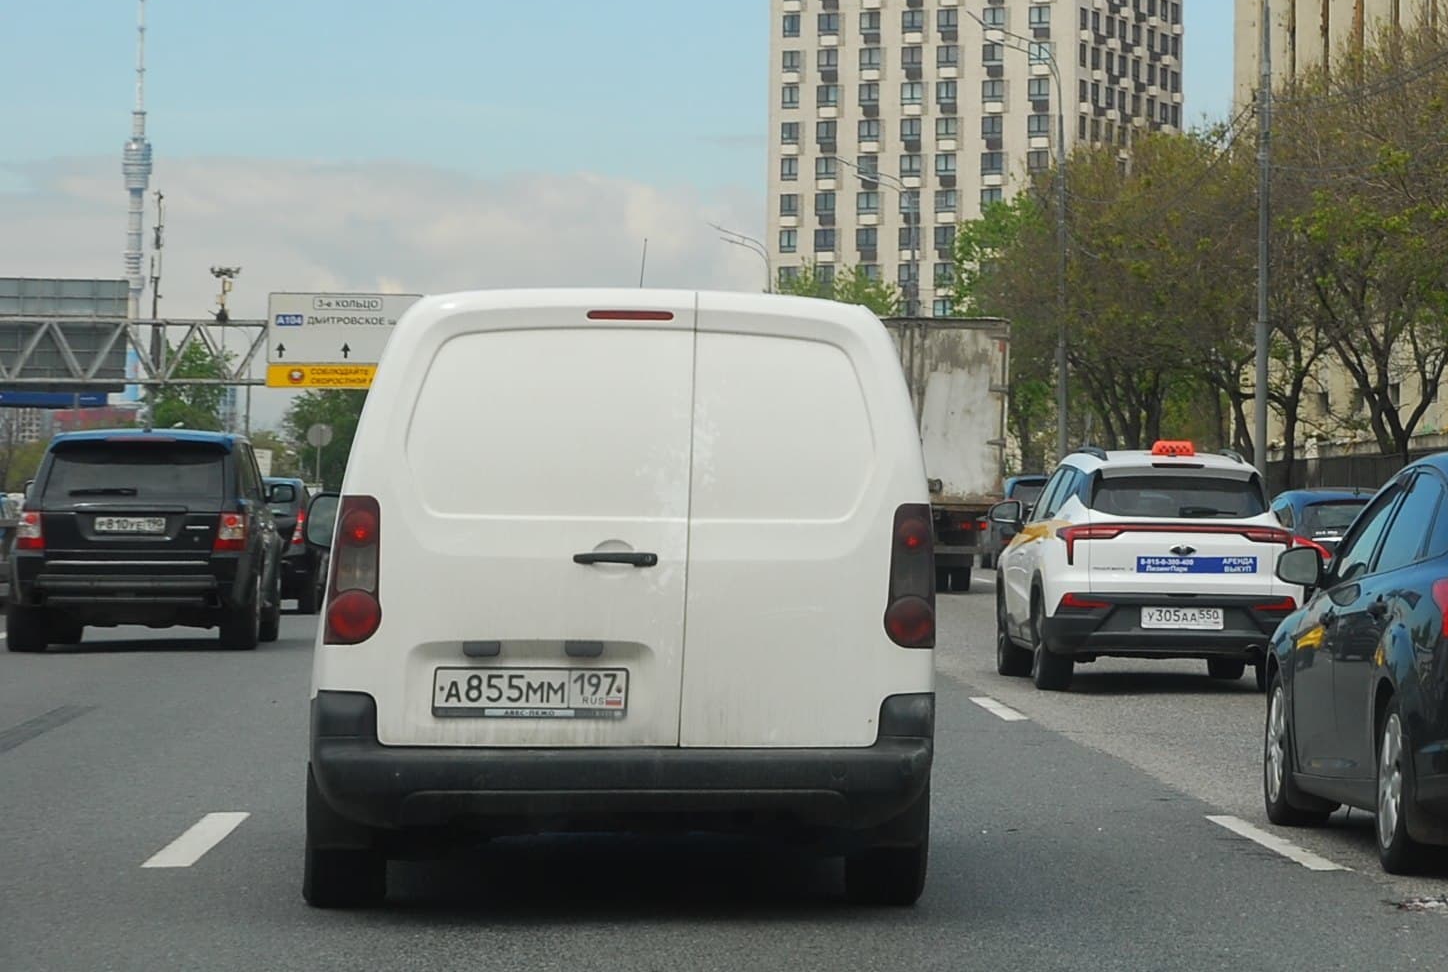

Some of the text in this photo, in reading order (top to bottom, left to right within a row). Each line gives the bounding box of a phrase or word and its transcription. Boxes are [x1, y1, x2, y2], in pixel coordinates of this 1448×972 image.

[335, 299, 379, 311] КОЛЬЦО
[307, 316, 385, 326] ДМИТРОВСКОЕ
[1222, 558, 1254, 566] АРЕНДА
[1224, 565, 1252, 573] ВЫКУП
[1200, 610, 1219, 620] 550
[445, 673, 617, 704] А855ММ 197
[582, 696, 604, 706] RUS
